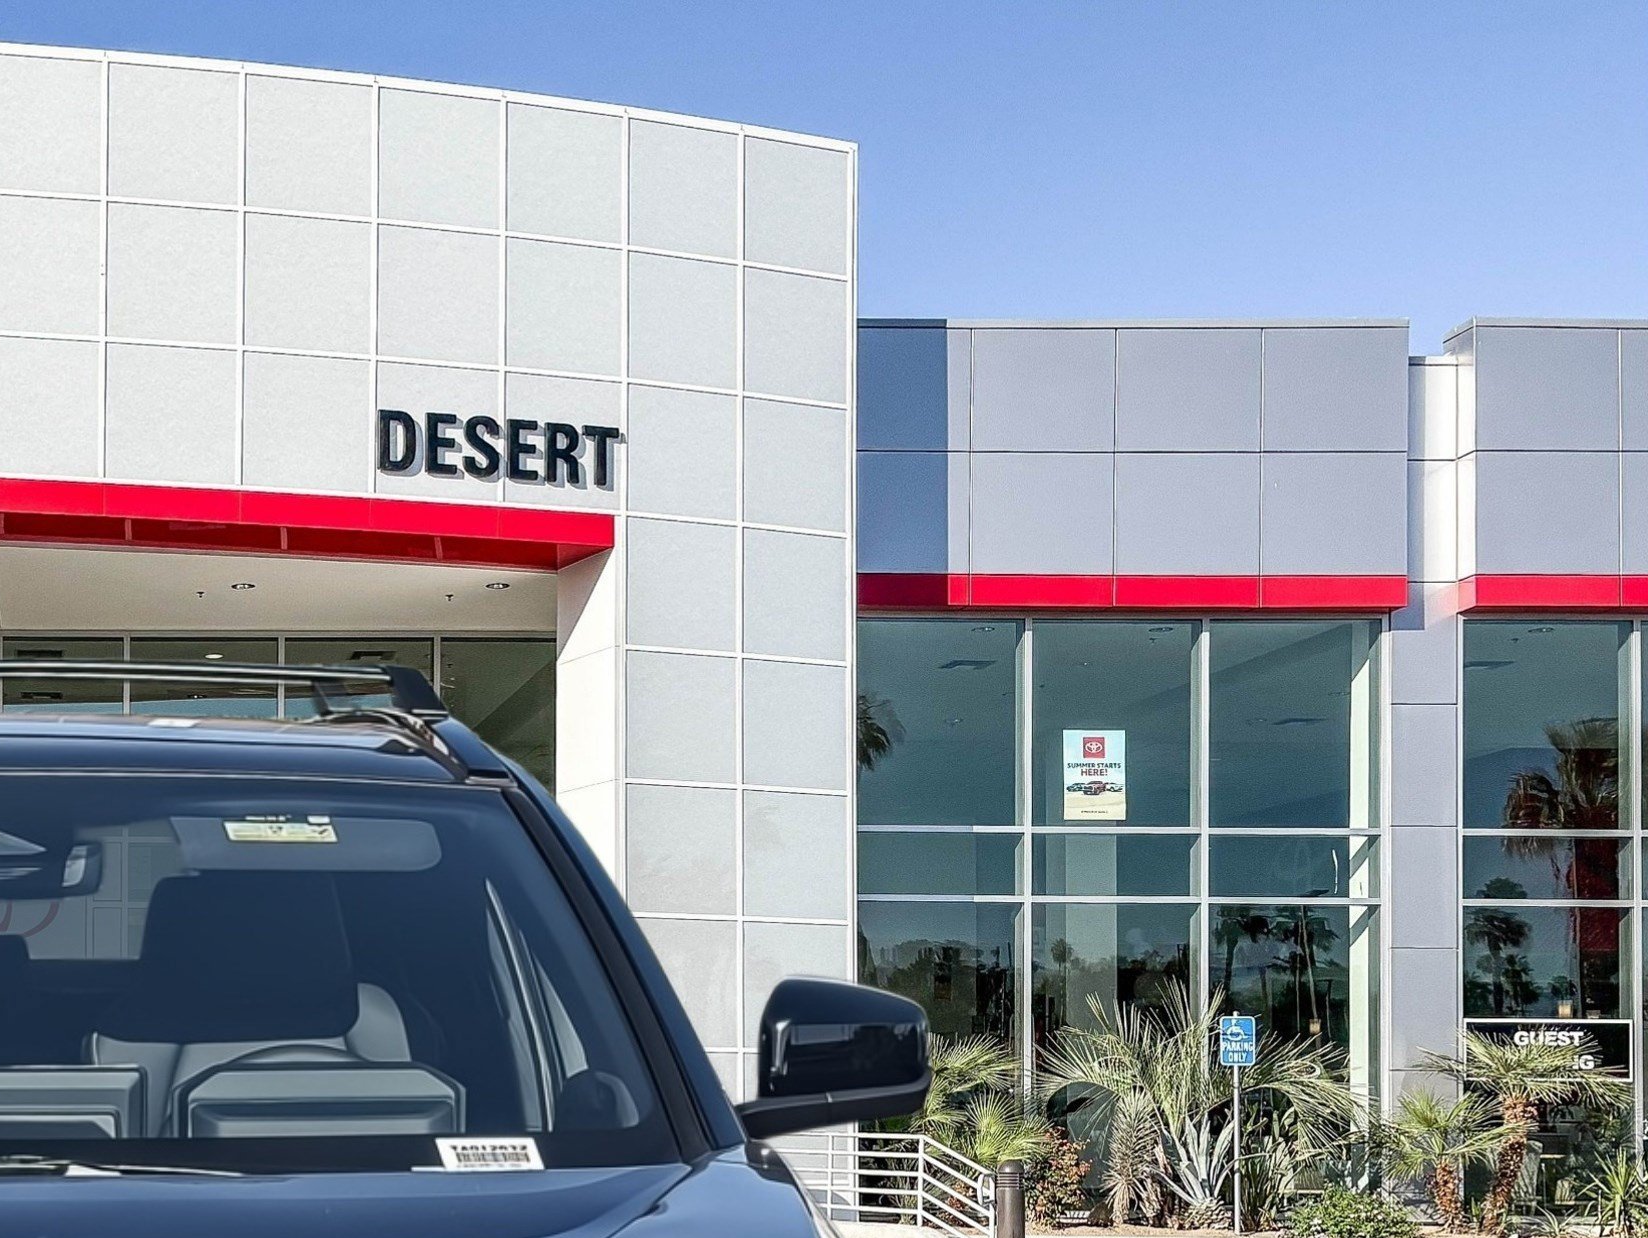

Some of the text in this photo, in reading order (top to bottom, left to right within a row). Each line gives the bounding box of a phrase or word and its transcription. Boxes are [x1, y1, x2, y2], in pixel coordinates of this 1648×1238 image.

[377, 408, 620, 487] DESERT
[1513, 1031, 1584, 1047] GUEST
[1222, 1042, 1254, 1052] PARKING
[1228, 1053, 1247, 1063] ONLY
